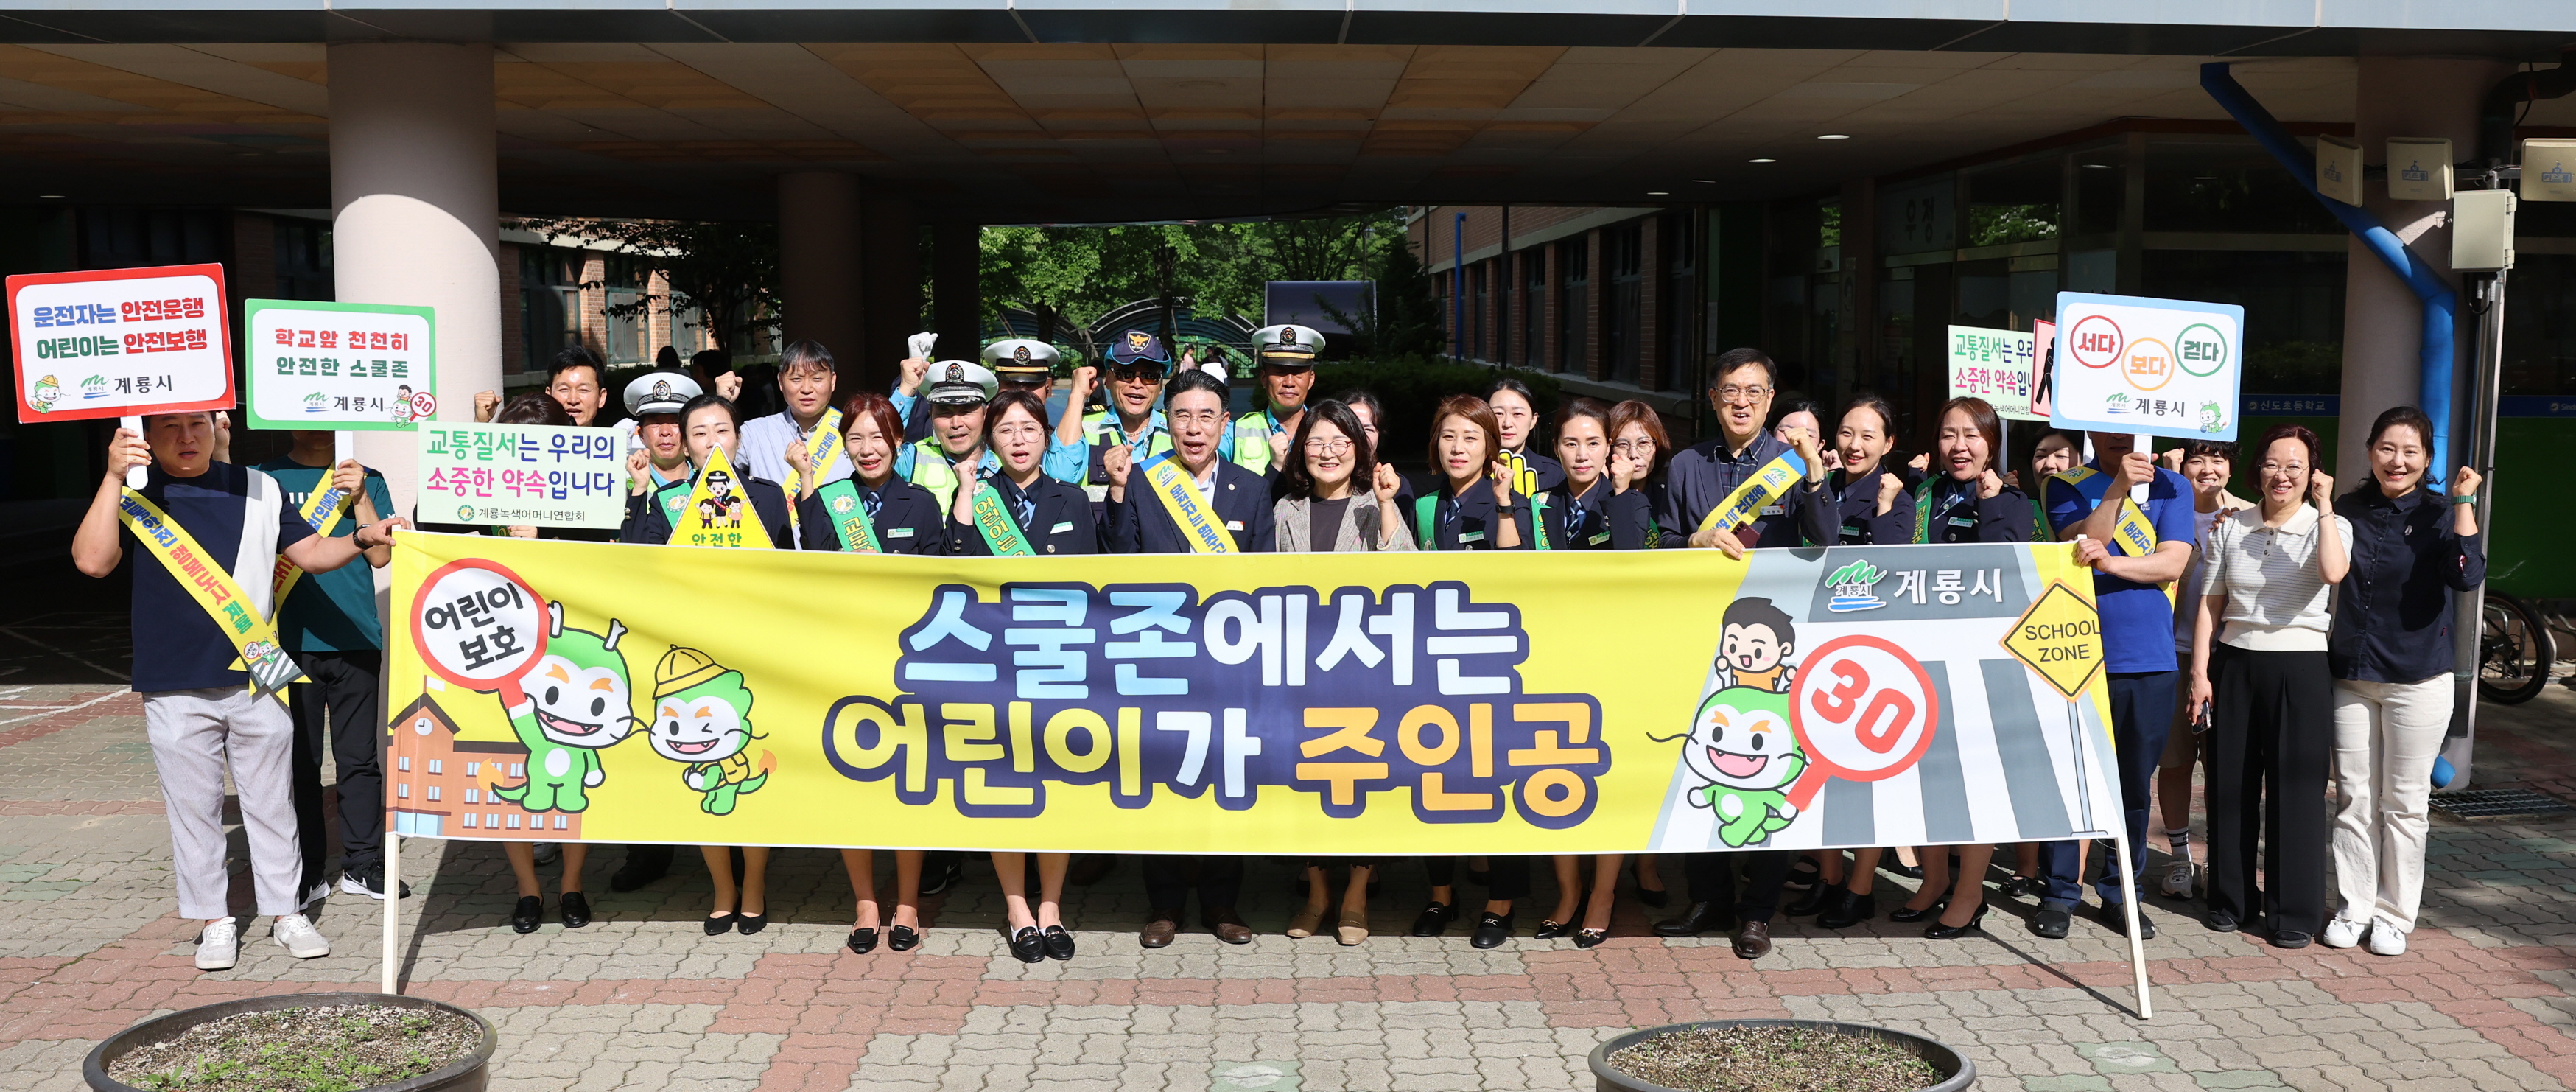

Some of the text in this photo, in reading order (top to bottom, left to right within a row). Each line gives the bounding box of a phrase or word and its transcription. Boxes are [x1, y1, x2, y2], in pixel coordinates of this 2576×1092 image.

[33, 297, 205, 328] 운전자는 안전운행
[37, 329, 207, 360] 어린이는 안전보행
[275, 328, 409, 351] 학교앞 천천히
[1955, 334, 2012, 363] 교통질서는
[2079, 332, 2116, 354] 서다
[2184, 339, 2219, 363] 걷다
[276, 357, 409, 378] 안전한 스쿨존
[2130, 354, 2166, 377] 보다
[115, 374, 172, 394] 계룡시
[1955, 367, 1991, 394] 소중한
[334, 395, 384, 413] 계룡시
[414, 399, 433, 413] 30
[2135, 396, 2186, 417] 계룡시
[2260, 400, 2326, 411] 신도초등학교
[427, 430, 614, 463] 교통질서는 우리의
[427, 466, 615, 500] 소중한 약속입니다
[478, 507, 586, 522] 계룡녹색어머니연합회
[975, 496, 1017, 552] 어린이는
[691, 532, 743, 547] 안전한
[169, 545, 231, 605] 행복도시
[222, 601, 253, 634] 계룡
[1836, 584, 1871, 597] 계룡시
[1894, 568, 2003, 605] 계룡시
[424, 582, 524, 631] 어린이
[2025, 620, 2101, 640] SCHOOL
[459, 625, 524, 672] 보호
[905, 587, 1518, 699] 스쿨존에서는
[2038, 644, 2090, 662] ZONE
[1811, 659, 1916, 754] 30
[835, 702, 1600, 817] 어린이가 주인공
